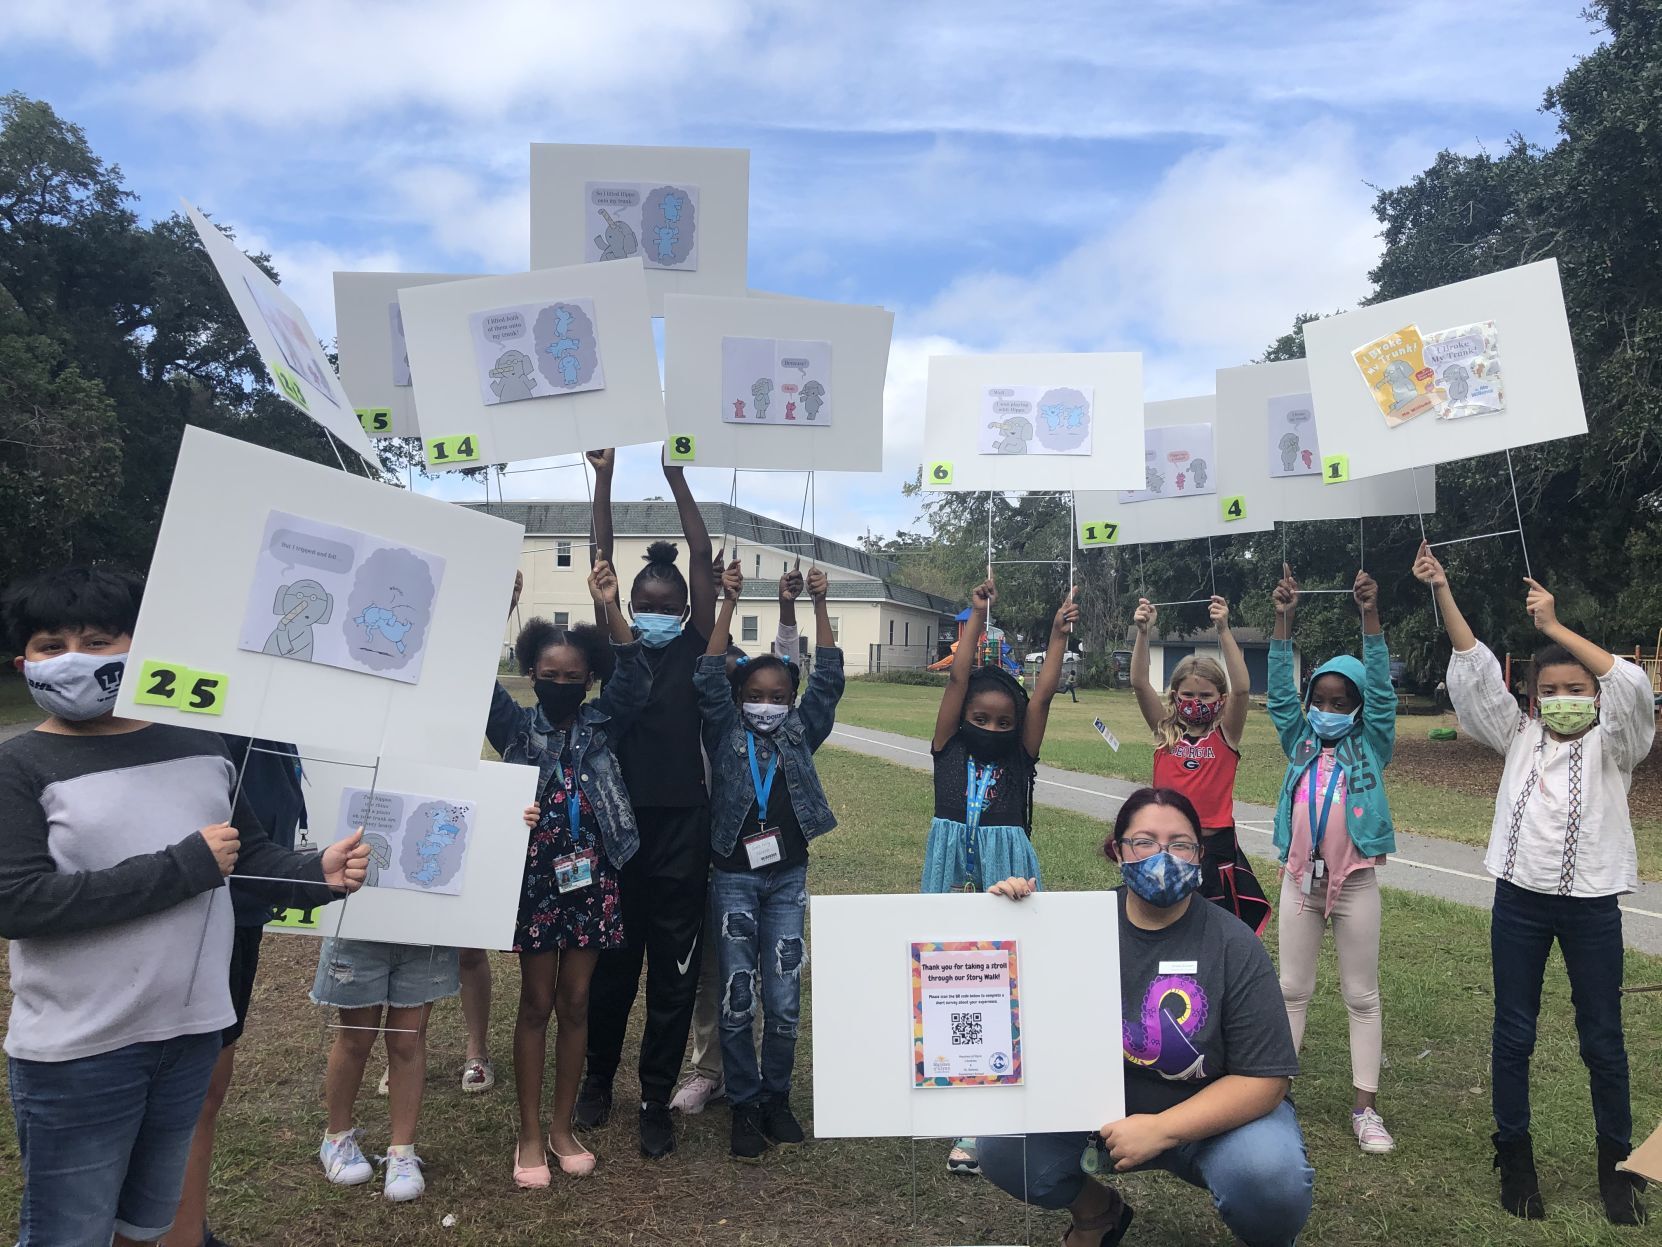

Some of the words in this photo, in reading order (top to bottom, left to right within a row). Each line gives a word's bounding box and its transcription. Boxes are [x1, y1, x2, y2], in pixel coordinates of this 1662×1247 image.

[1368, 338, 1403, 359] Broke
[1378, 342, 1418, 364] Trunk!
[1443, 342, 1471, 352] Broke
[675, 436, 692, 455] 8
[933, 464, 949, 480] 6
[1328, 462, 1343, 479] 1
[1227, 498, 1243, 518] 4
[1085, 522, 1118, 541] 17
[146, 669, 220, 709] 25
[964, 963, 984, 972] taking
[928, 974, 953, 984] through
[966, 974, 983, 982] Story
